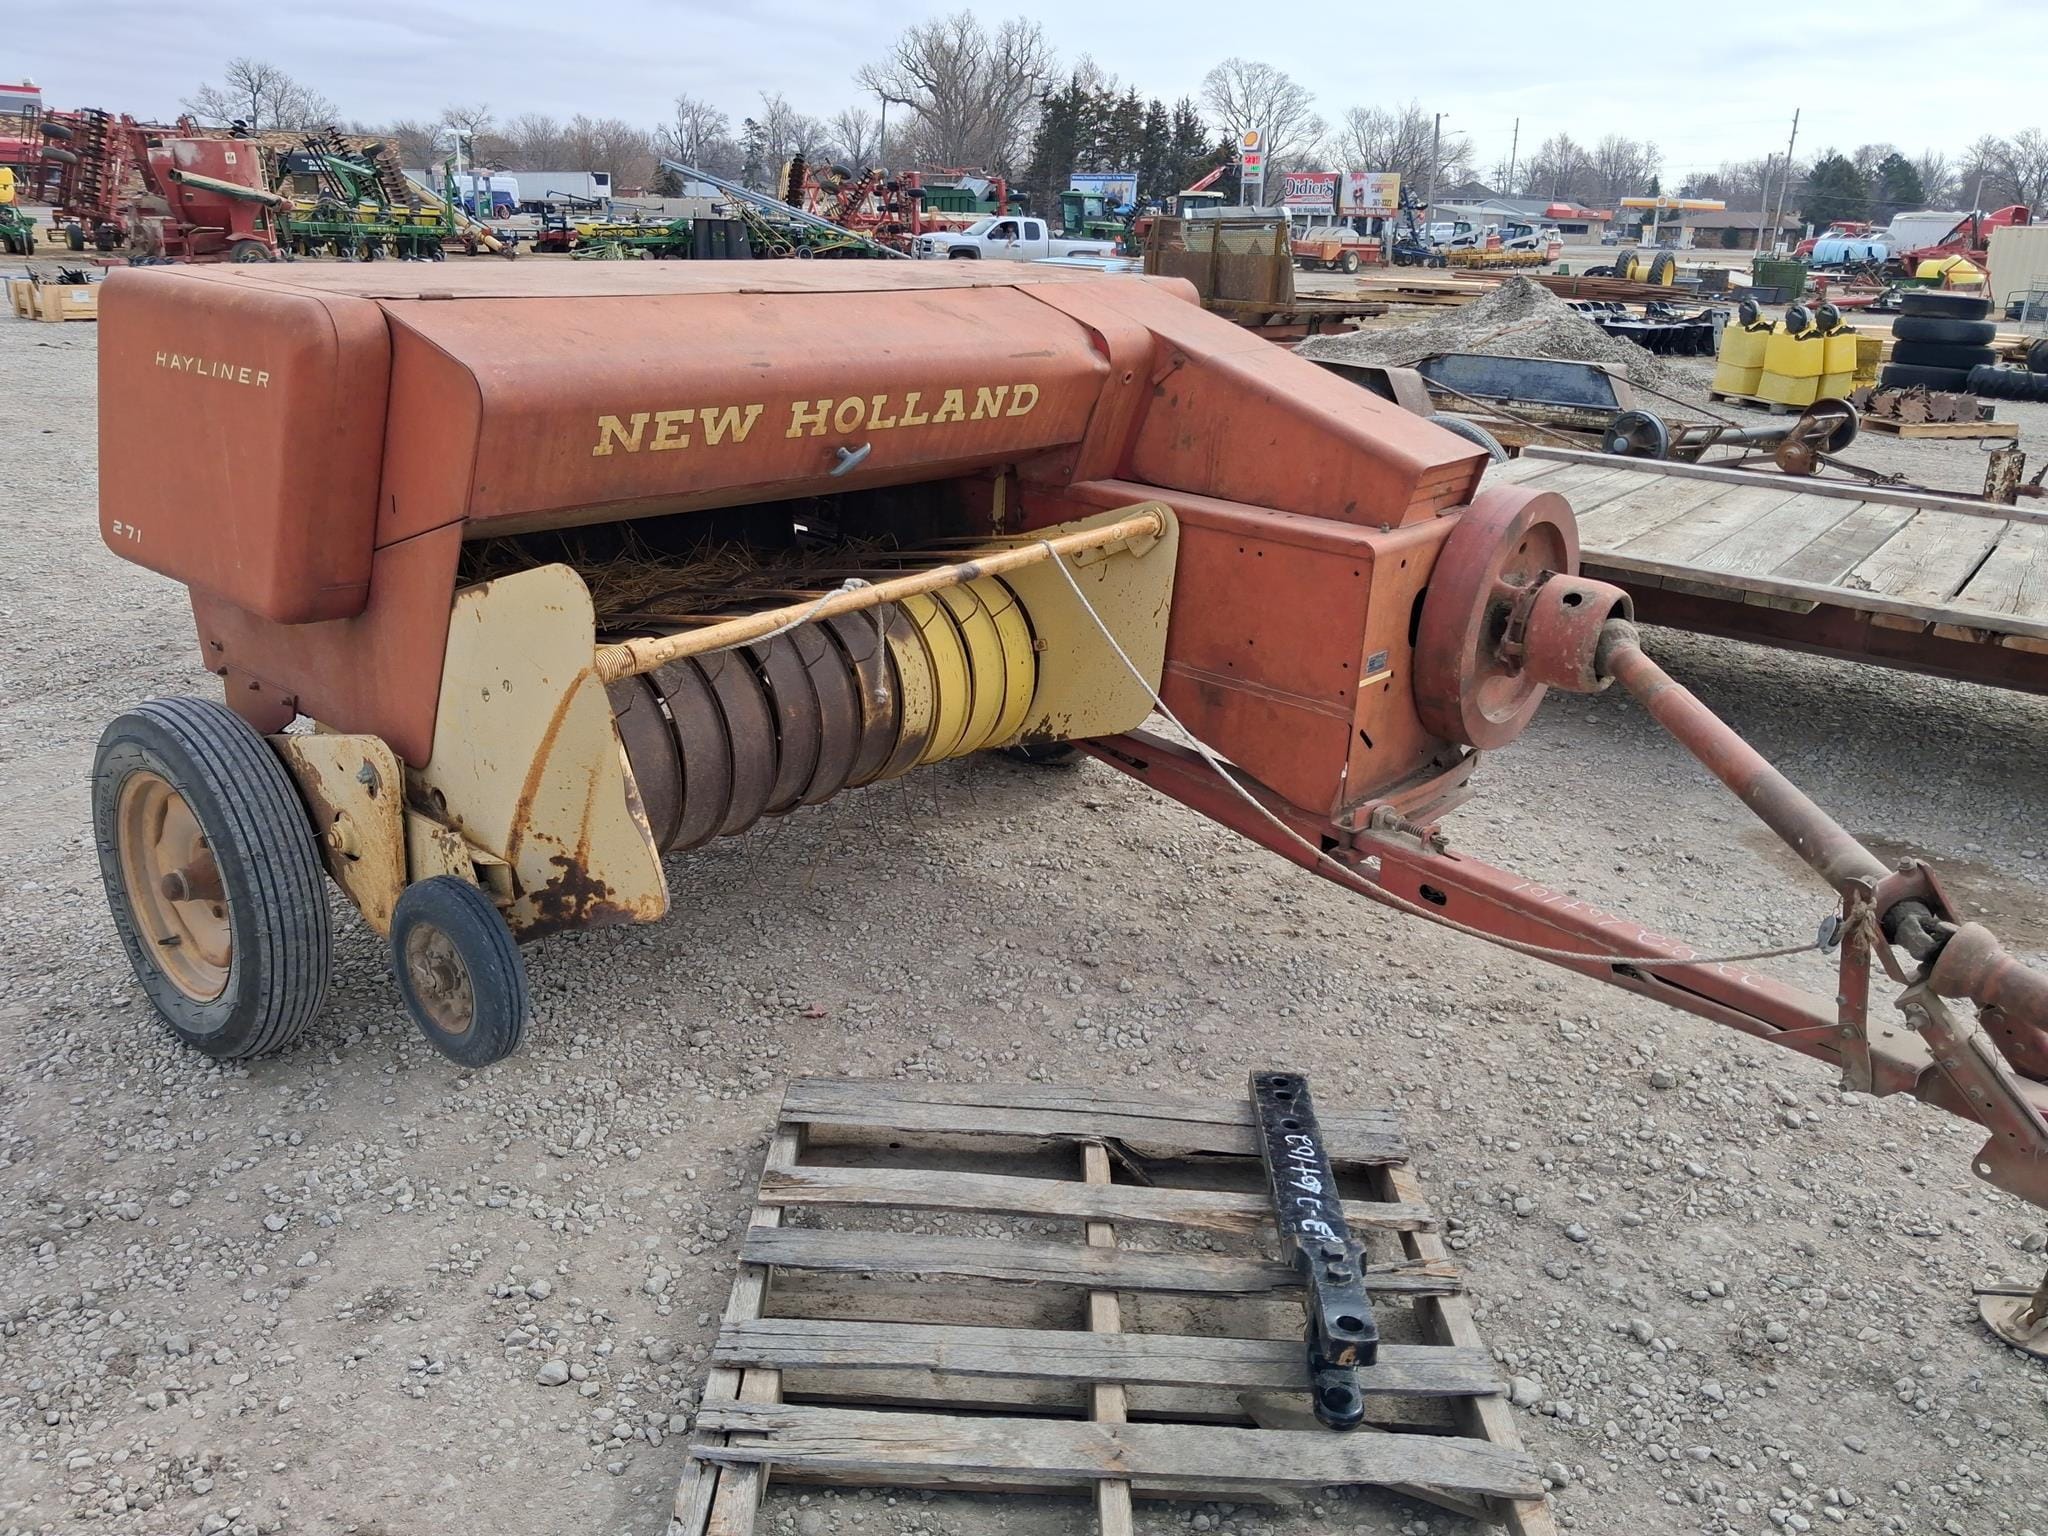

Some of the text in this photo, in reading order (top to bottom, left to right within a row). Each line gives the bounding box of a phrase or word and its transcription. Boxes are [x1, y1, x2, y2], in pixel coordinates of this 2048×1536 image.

[1284, 178, 1334, 197] Didier's
[155, 351, 270, 389] HAYLINER
[592, 383, 1040, 457] NEW HOLLAND
[112, 519, 142, 543] 271
